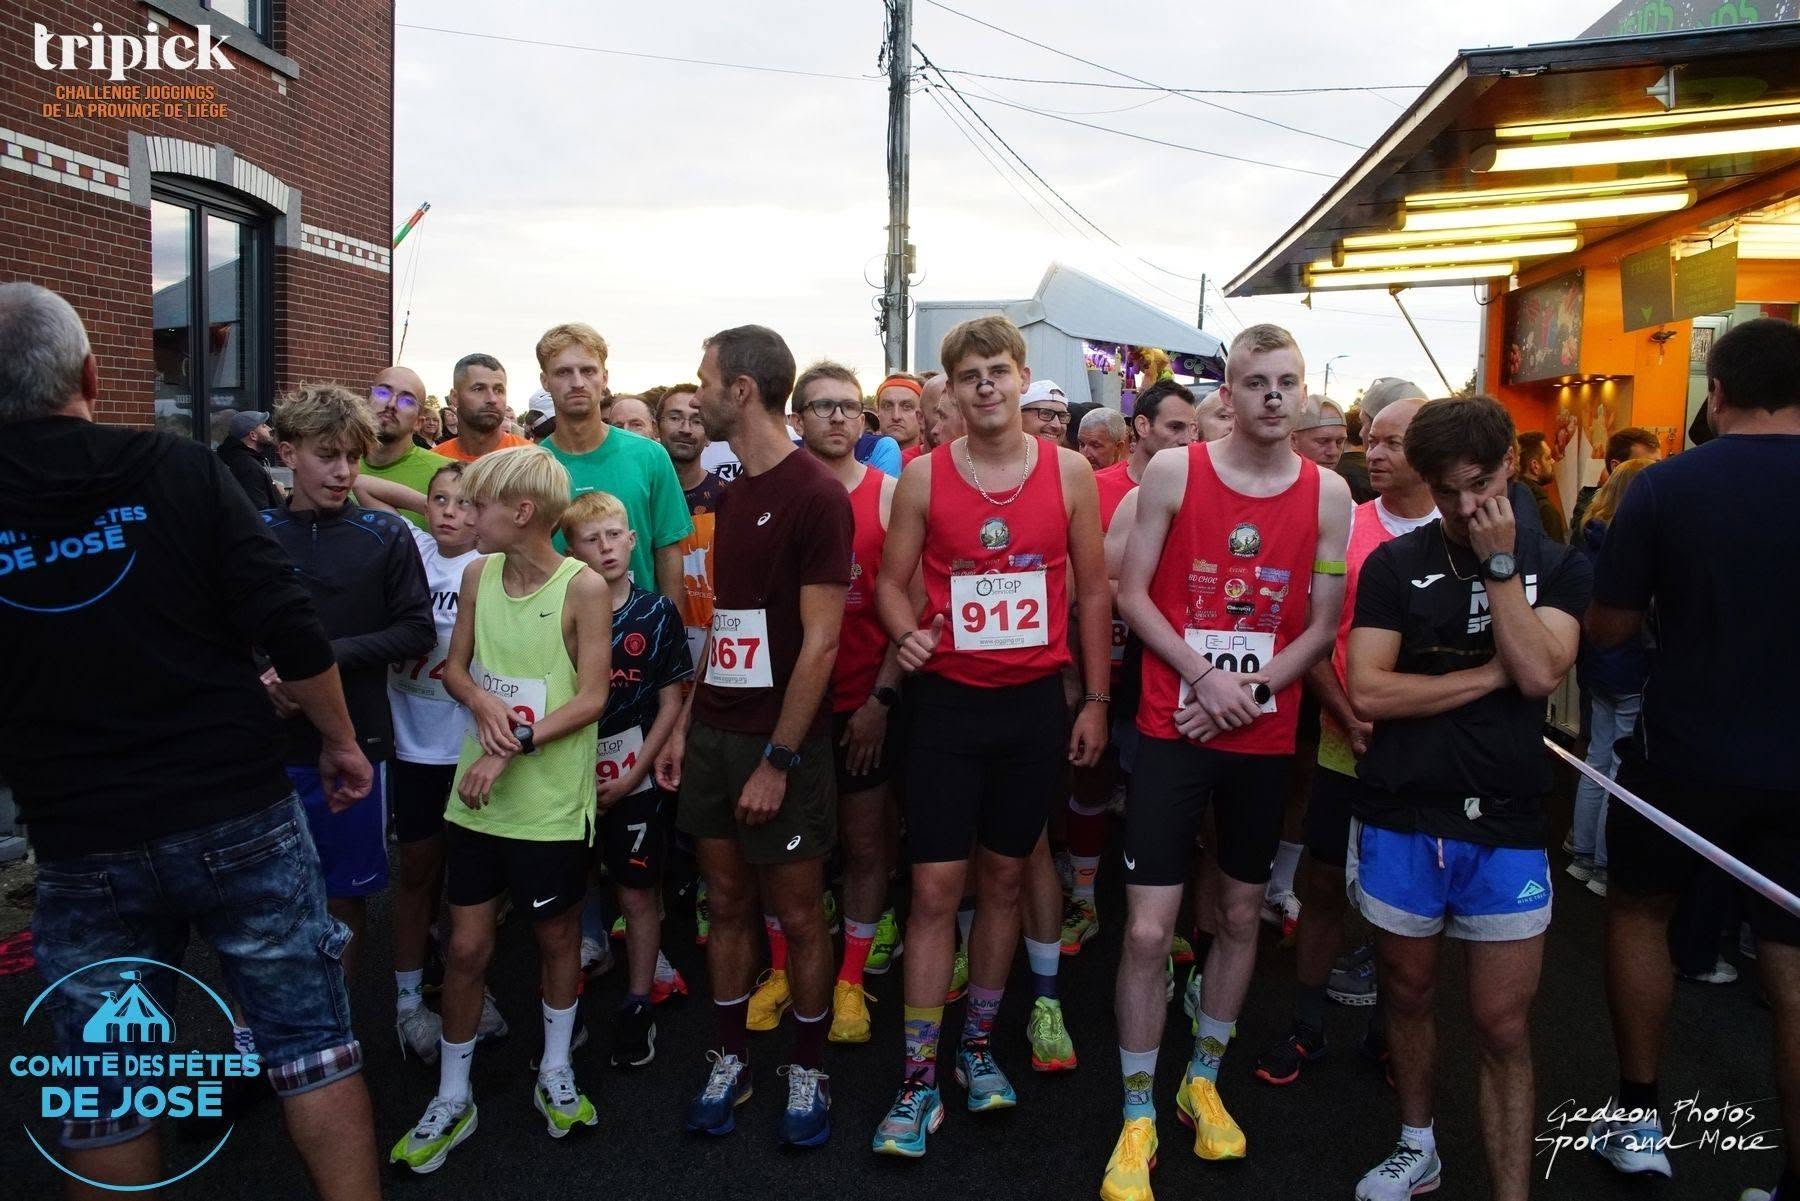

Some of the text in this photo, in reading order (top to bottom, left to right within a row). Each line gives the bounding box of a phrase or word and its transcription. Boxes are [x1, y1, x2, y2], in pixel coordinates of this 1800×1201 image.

[962, 599, 1040, 633] 912
[711, 636, 760, 669] 867
[626, 822, 648, 853] 7
